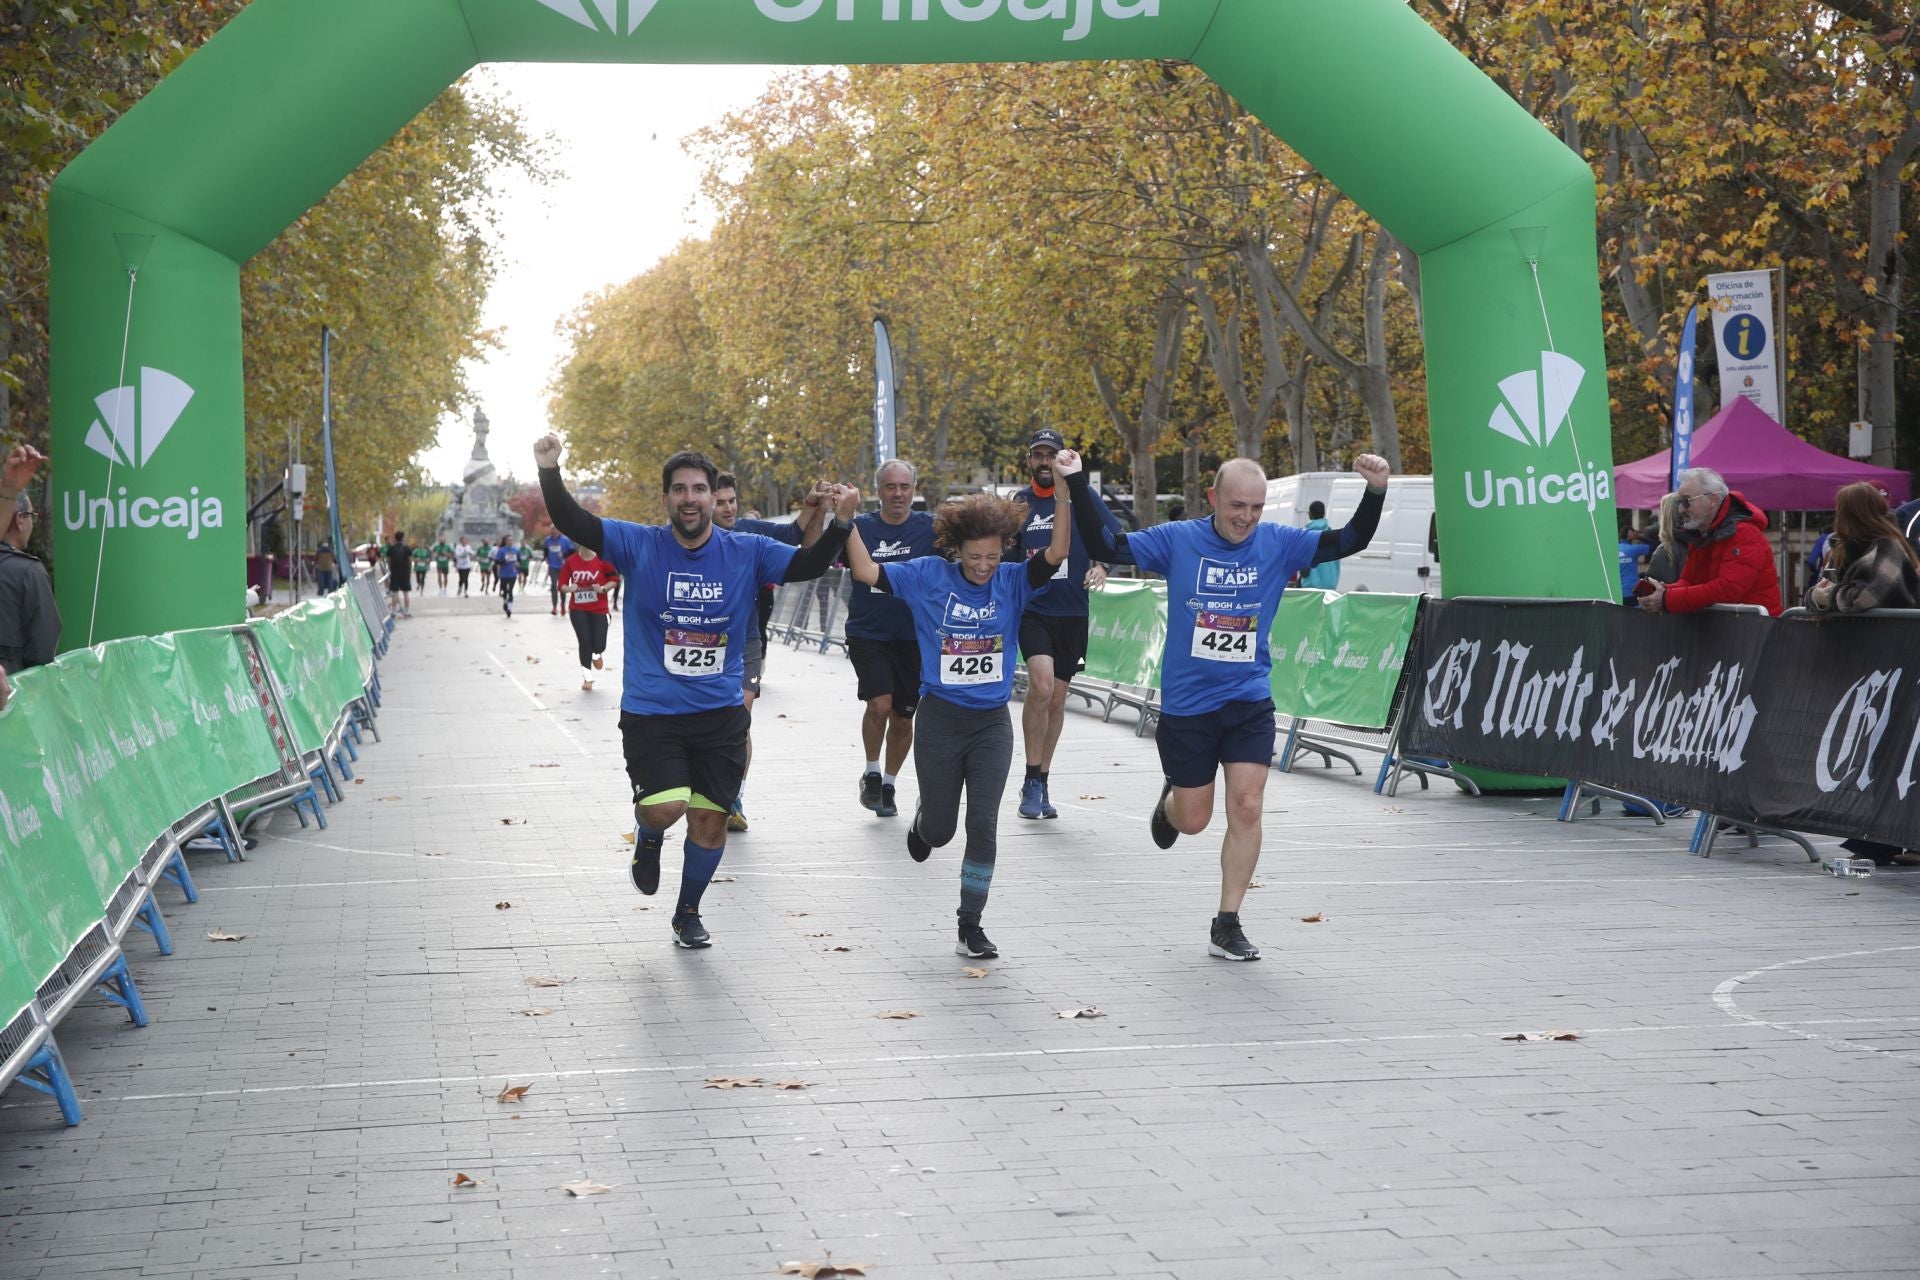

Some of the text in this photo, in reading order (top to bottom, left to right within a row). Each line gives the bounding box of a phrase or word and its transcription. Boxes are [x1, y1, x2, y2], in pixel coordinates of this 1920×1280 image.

[1716, 280, 1754, 290] Oficina de
[1464, 461, 1610, 513] Unicaja
[63, 486, 223, 540] Unicaja
[871, 548, 911, 558] MICHELIN
[572, 570, 600, 583] gmv
[1224, 571, 1258, 585] ADF
[577, 592, 594, 600] 416
[690, 587, 723, 599] ADF
[683, 615, 701, 623] DGH
[968, 604, 996, 620] ADF
[1201, 631, 1248, 653] 424
[672, 648, 717, 667] 425
[949, 656, 993, 675] 426
[1424, 638, 1481, 729] El
[1481, 639, 1593, 741] Norte
[1633, 656, 1758, 775] Castilla
[1816, 667, 1903, 792] El
